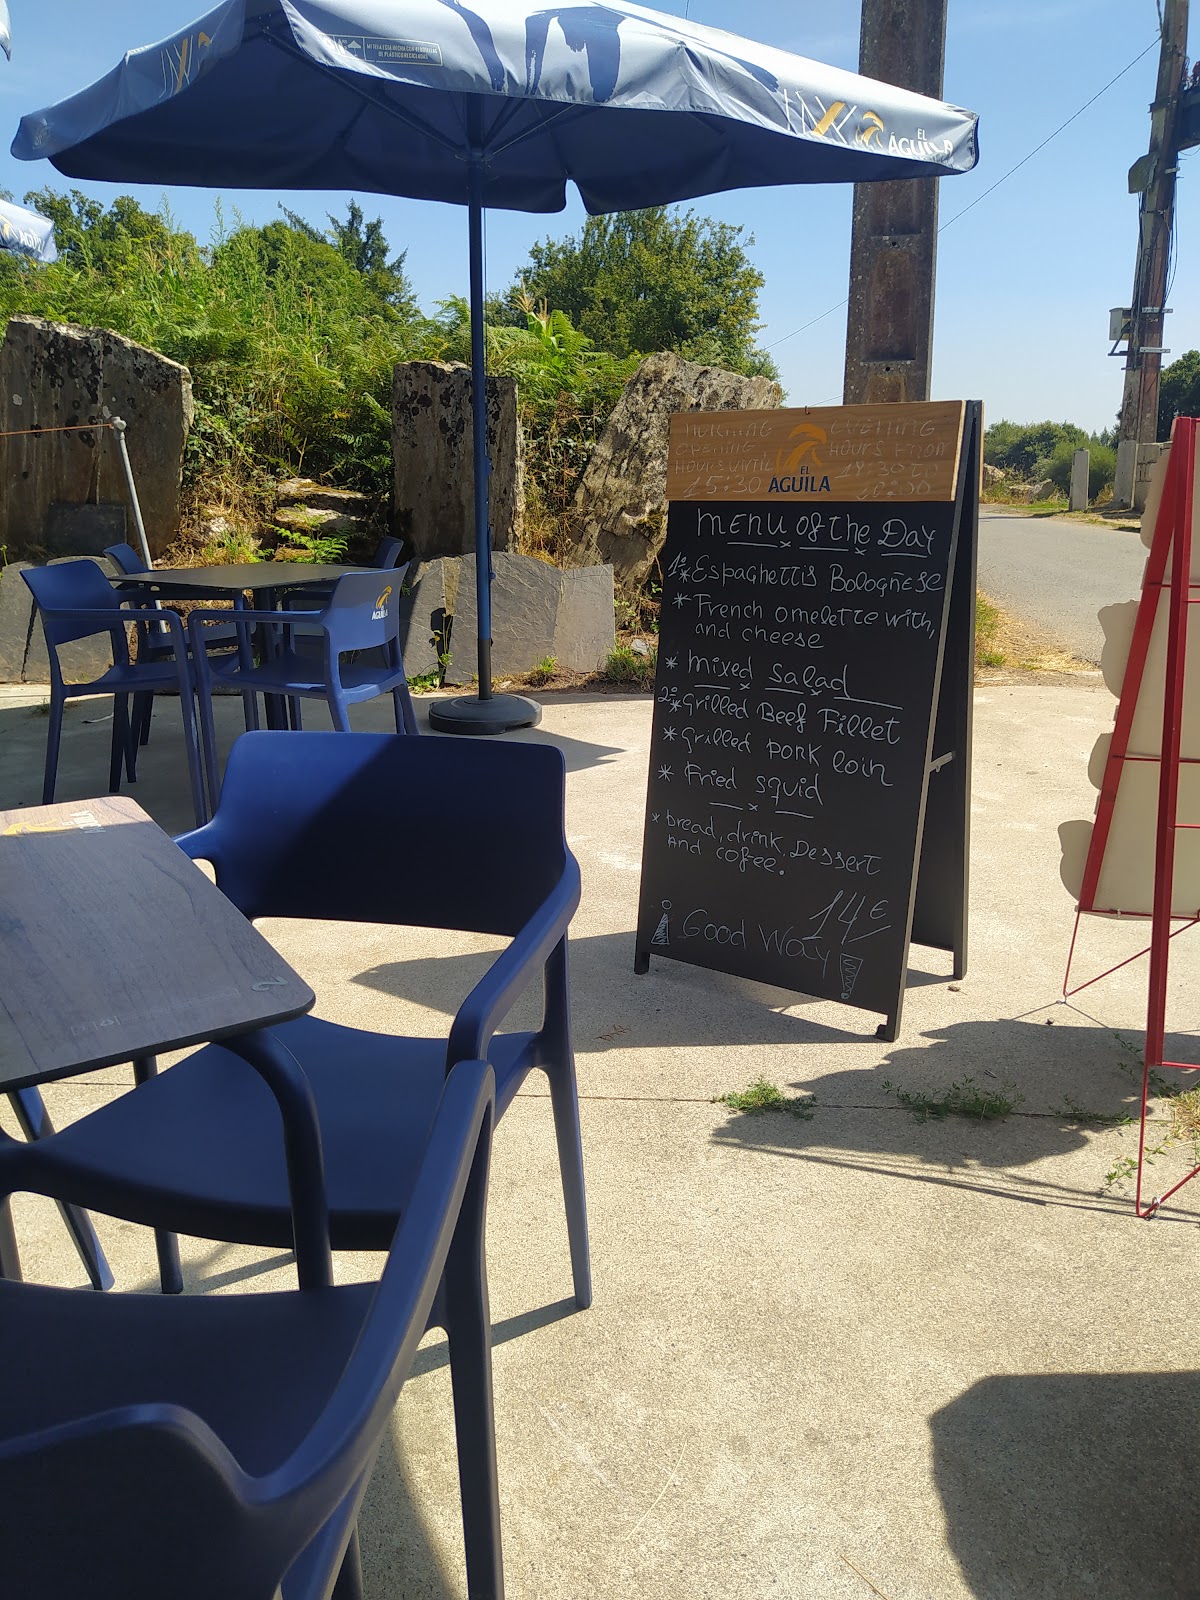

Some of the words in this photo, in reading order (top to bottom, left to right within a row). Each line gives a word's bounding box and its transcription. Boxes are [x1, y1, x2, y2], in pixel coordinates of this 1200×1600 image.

[917, 127, 928, 142] EL
[767, 474, 831, 493] ÁGUILA
[800, 465, 811, 475] EL
[683, 475, 761, 498] 15:30
[877, 518, 937, 555] Day
[692, 593, 763, 621] French
[775, 605, 879, 627] omelette
[694, 622, 731, 640] and
[742, 627, 825, 649] cheese
[682, 693, 750, 719] Grilled
[757, 701, 807, 734] Beef
[817, 708, 901, 745] Fillet
[681, 726, 752, 754] Grilled
[832, 750, 894, 787] loin
[684, 761, 738, 790] Fried
